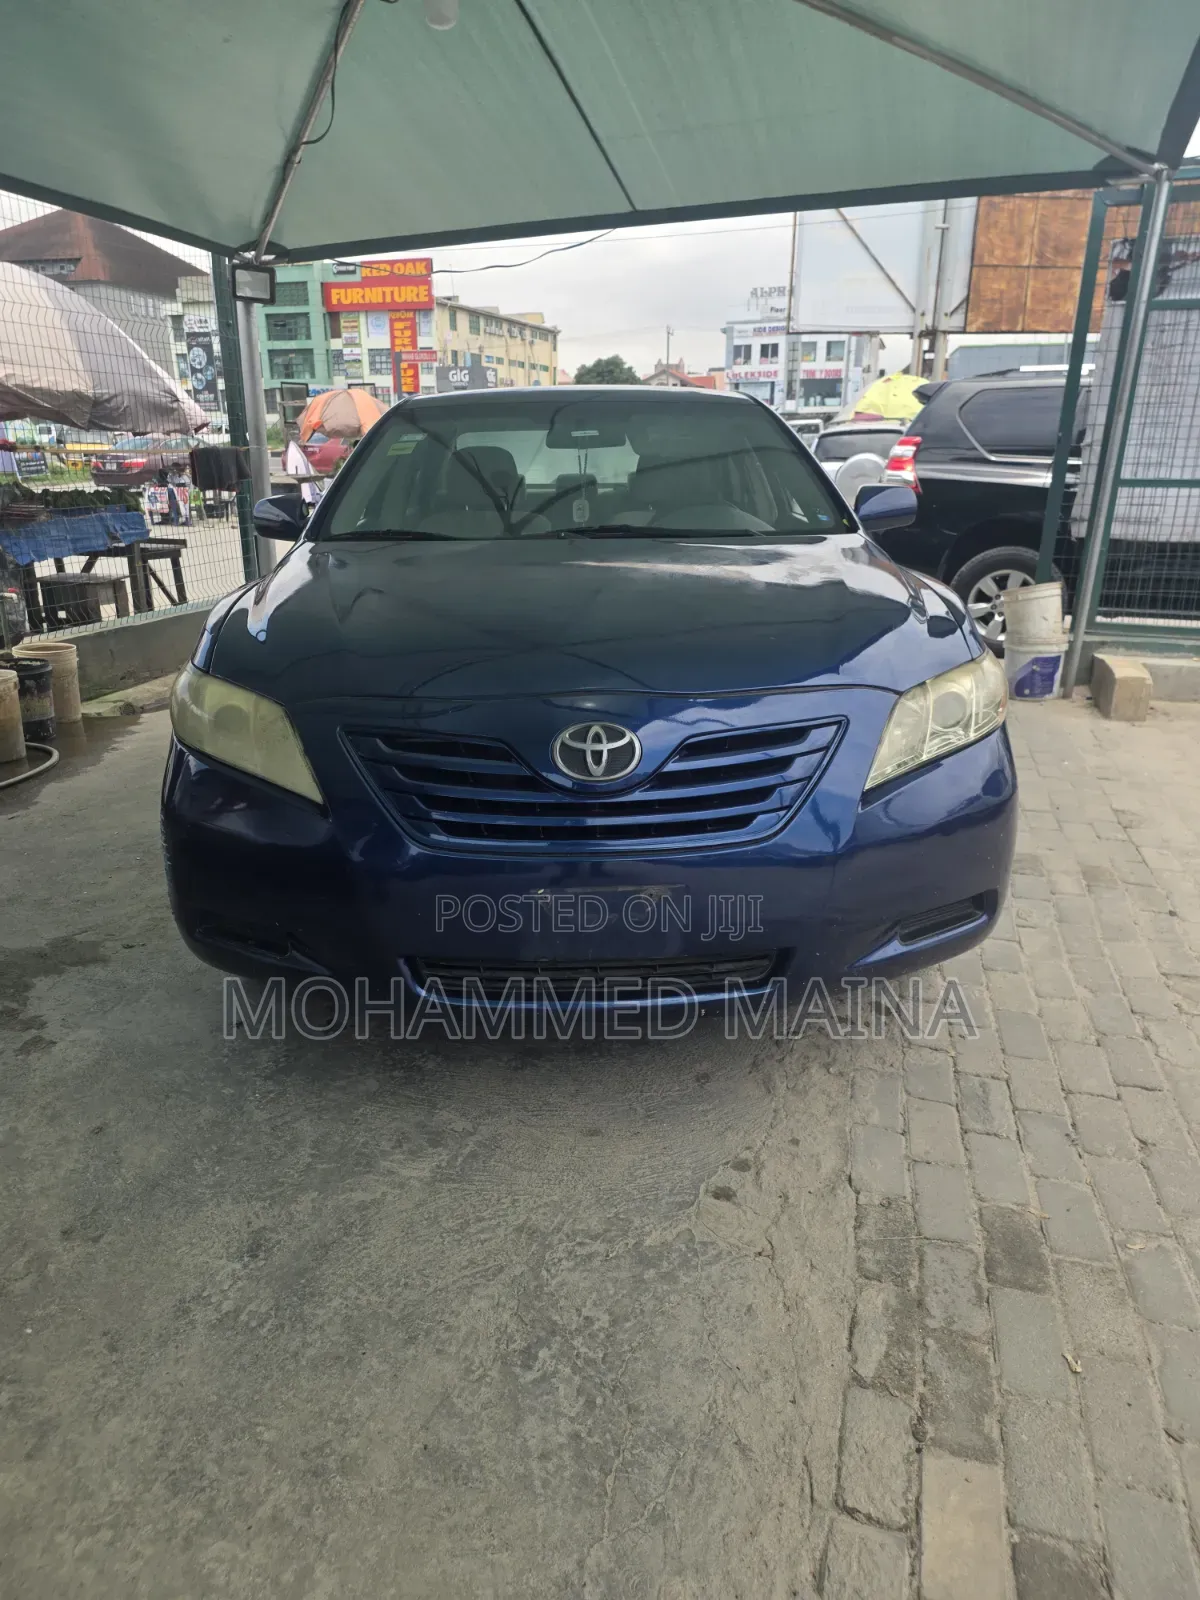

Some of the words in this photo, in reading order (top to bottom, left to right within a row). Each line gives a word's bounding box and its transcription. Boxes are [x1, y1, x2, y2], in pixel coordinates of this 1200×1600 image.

[361, 263, 391, 277] RED
[393, 261, 428, 276] OAK
[331, 285, 429, 305] FURNITURE
[750, 286, 790, 298] ALPH
[393, 321, 414, 392] FURNTURE
[448, 368, 470, 382] GIG
